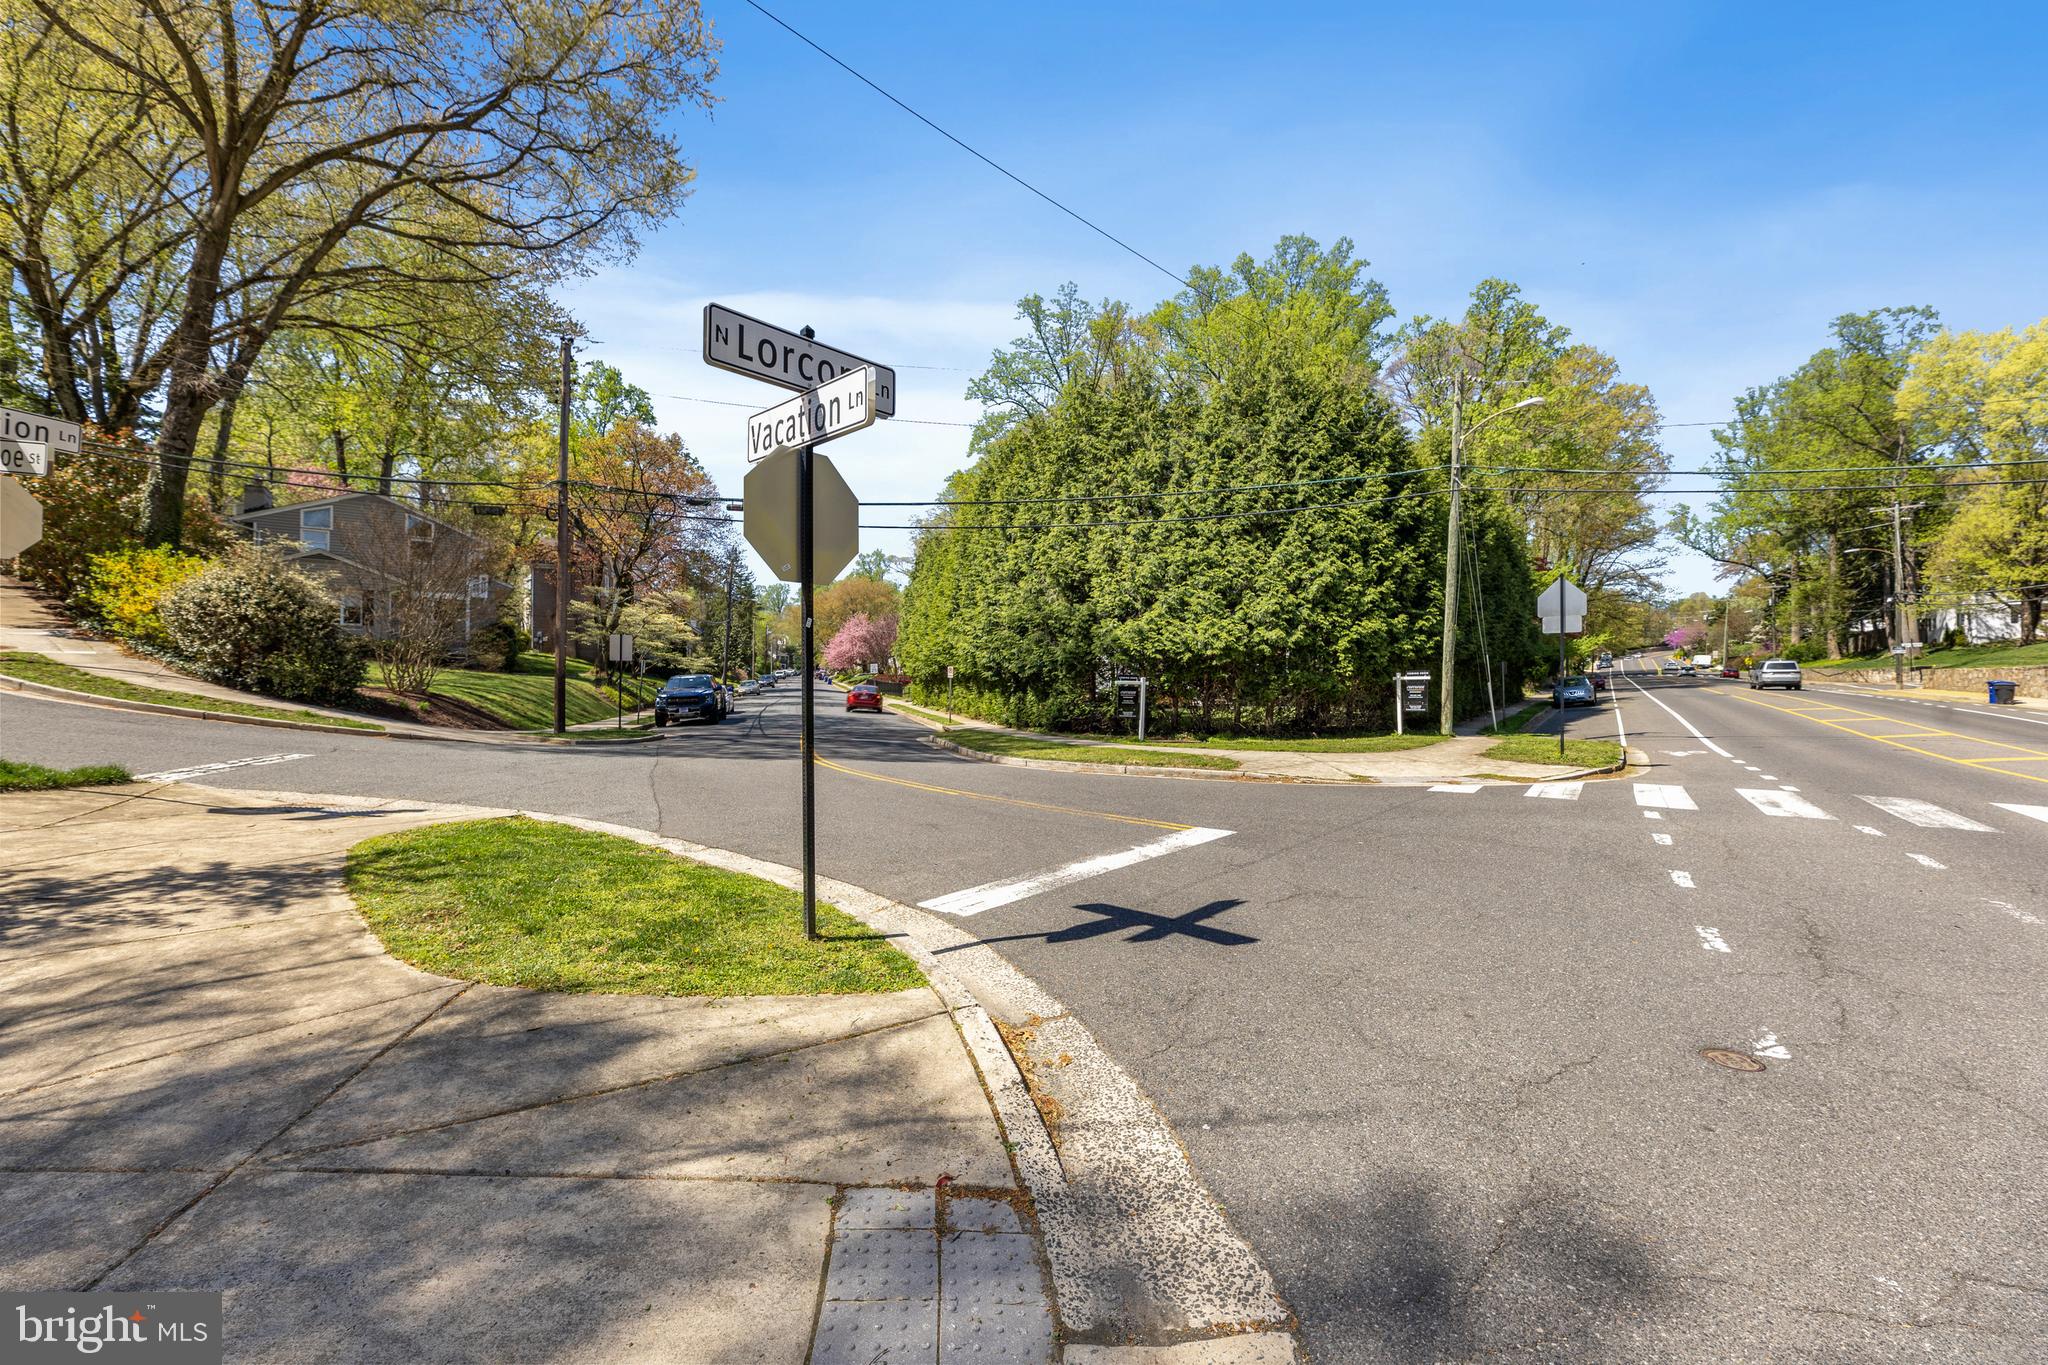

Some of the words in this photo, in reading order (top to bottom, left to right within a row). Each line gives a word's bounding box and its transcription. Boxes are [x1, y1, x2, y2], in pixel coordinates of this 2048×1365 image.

[715, 324, 729, 346] N
[751, 395, 841, 454] Vacation
[848, 390, 863, 410] Ln
[59, 430, 77, 444] Ln
[28, 453, 41, 465] St
